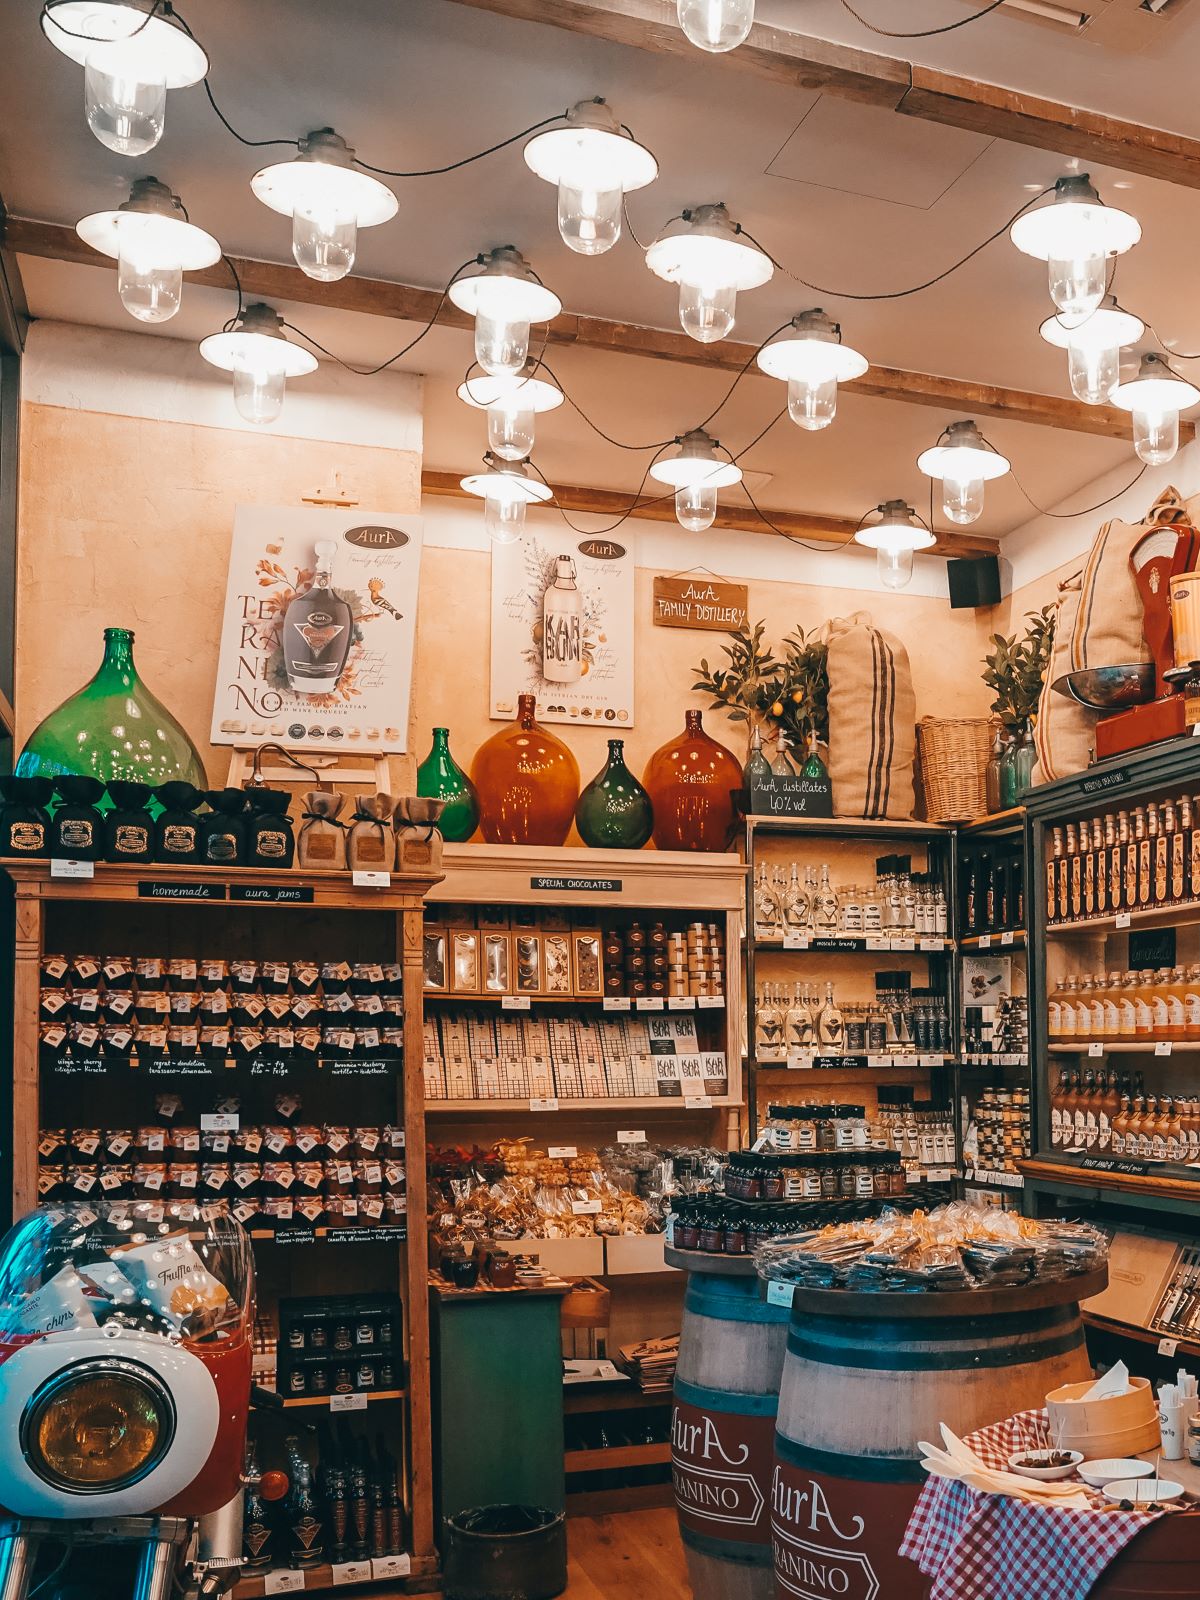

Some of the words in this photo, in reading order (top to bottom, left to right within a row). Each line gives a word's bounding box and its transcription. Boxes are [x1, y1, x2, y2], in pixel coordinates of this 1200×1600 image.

[353, 529, 401, 546] AurA
[585, 542, 618, 556] AurA
[681, 582, 720, 602] AurA
[658, 600, 692, 621] FAMILY
[694, 603, 746, 627] DISTILLERY
[753, 778, 778, 793] AurA
[782, 778, 828, 793] distillates
[769, 794, 792, 811] 40%
[793, 797, 807, 811] vol
[537, 878, 565, 889] SPECIAL
[567, 879, 613, 890] CHOCOLATES
[152, 885, 210, 897] homemade
[245, 888, 271, 899] aura
[276, 887, 302, 902] jams
[157, 1264, 192, 1286] Truffle
[46, 1309, 74, 1331] chips
[672, 1468, 740, 1509] RANINO
[772, 1536, 849, 1593] RANINO
